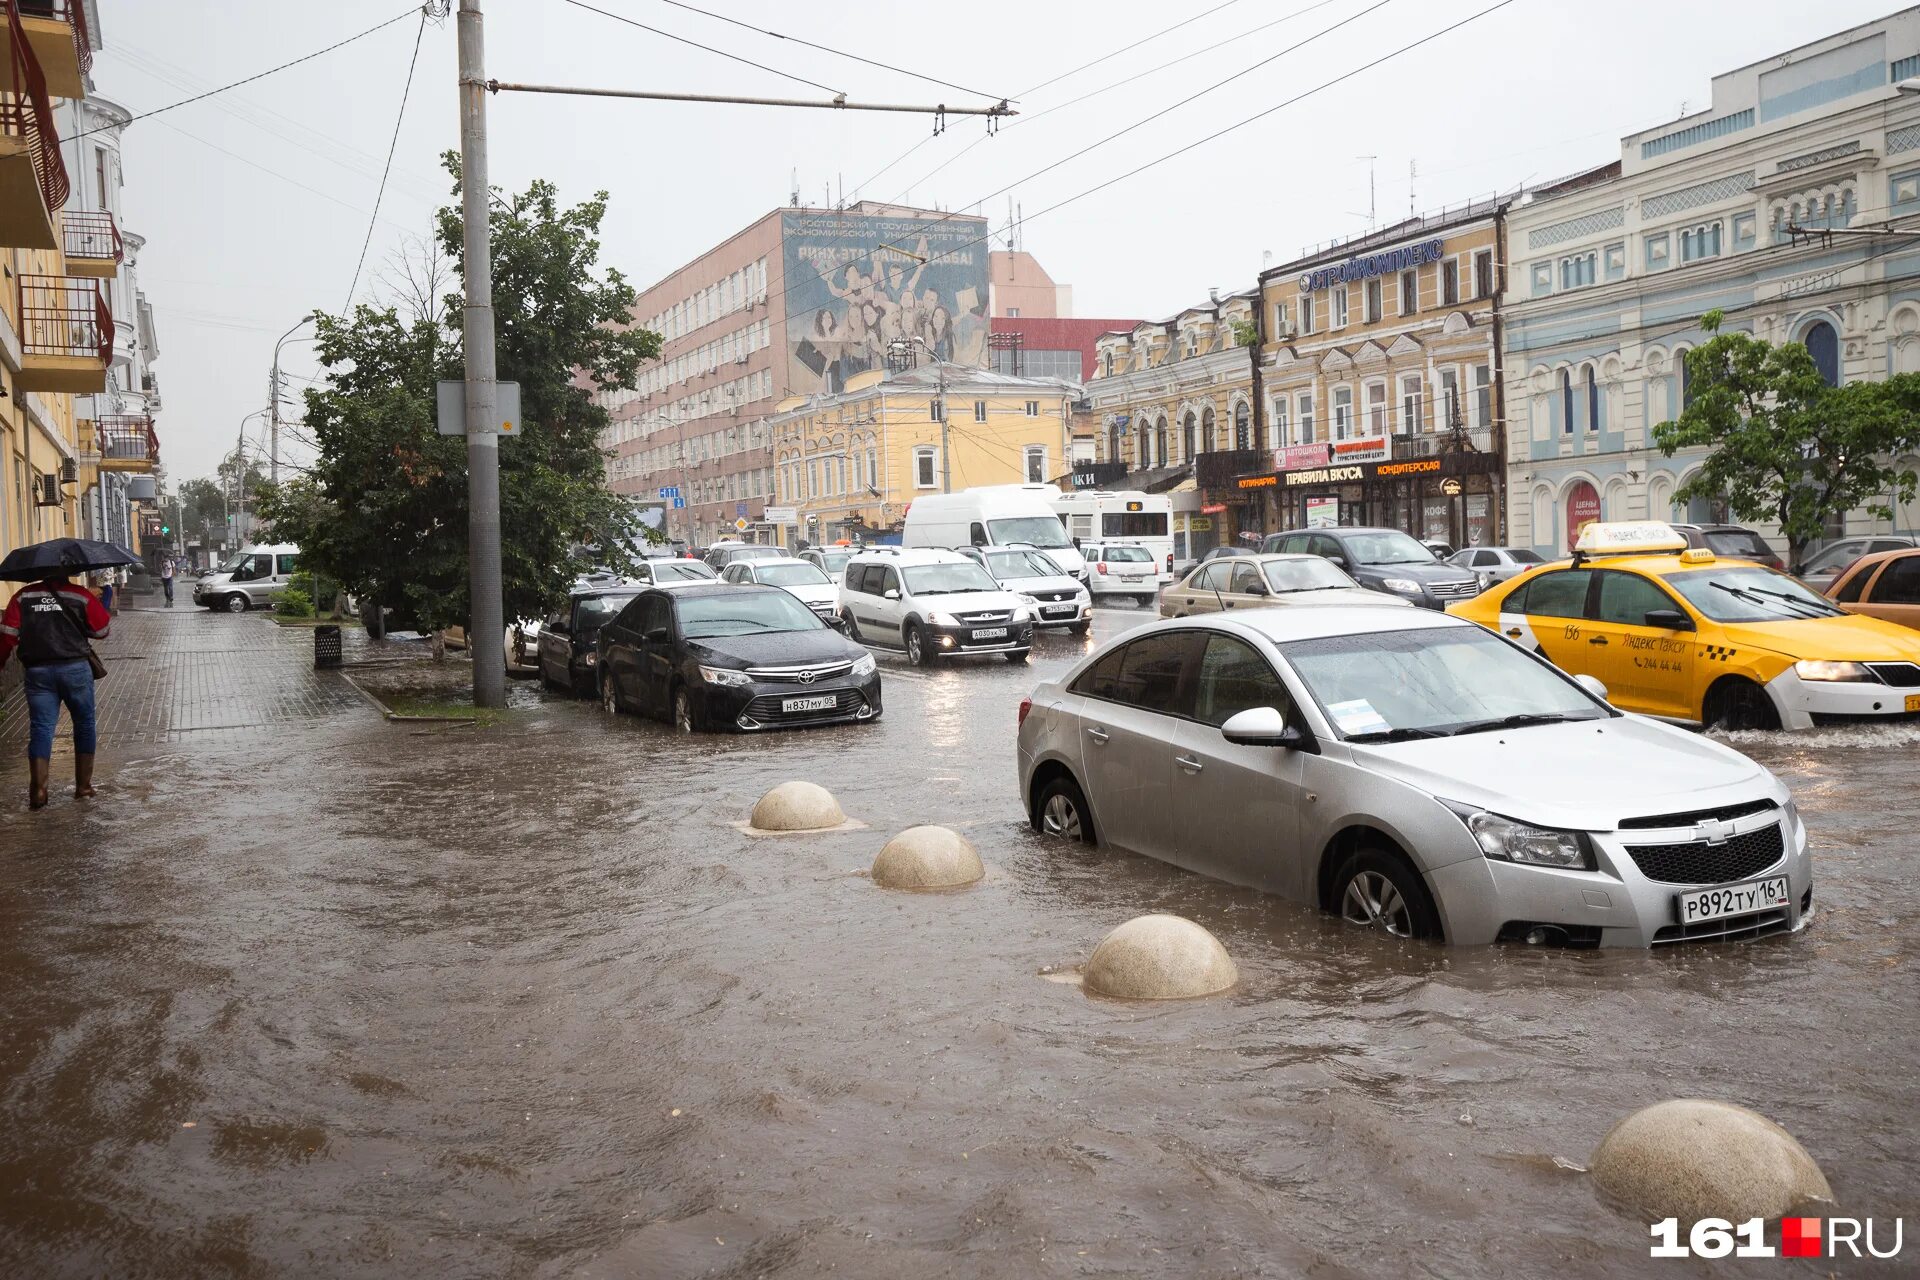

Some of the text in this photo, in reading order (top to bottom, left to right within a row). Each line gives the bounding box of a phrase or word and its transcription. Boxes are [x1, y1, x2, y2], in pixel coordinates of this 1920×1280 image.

[800, 219, 975, 233] РОСТОВСКИЙ ГОСУДАРСТВЕННЫЙ
[783, 227, 877, 238] ЭКОНОМИЧЕСКИЙ
[884, 231, 953, 241] УНИВЕРСИТЕТ
[1309, 239, 1444, 290] СТРОЙКОМПЛЕКС
[1286, 446, 1327, 457] АВТОШКОЛА
[1337, 451, 1385, 462] ТУРИСТИЧЕСКИЙ ЦЕНТР
[1377, 460, 1441, 476] КОНДИТЕРСКАЯ
[1238, 476, 1277, 489] КУЛИНАРИЯ
[1286, 466, 1364, 485] ПРАВИЛА ВКУСА
[1424, 505, 1447, 517] КОФЕ
[1576, 501, 1597, 509] ЦЕНЫ
[1565, 624, 1580, 640] 136
[1622, 633, 1686, 653] Яндекс Такси
[1643, 657, 1682, 672] 244 44 44
[786, 699, 822, 711] Н837МУ
[1687, 879, 1785, 919] Р892ТУ 161
[1765, 897, 1778, 905] RUS
